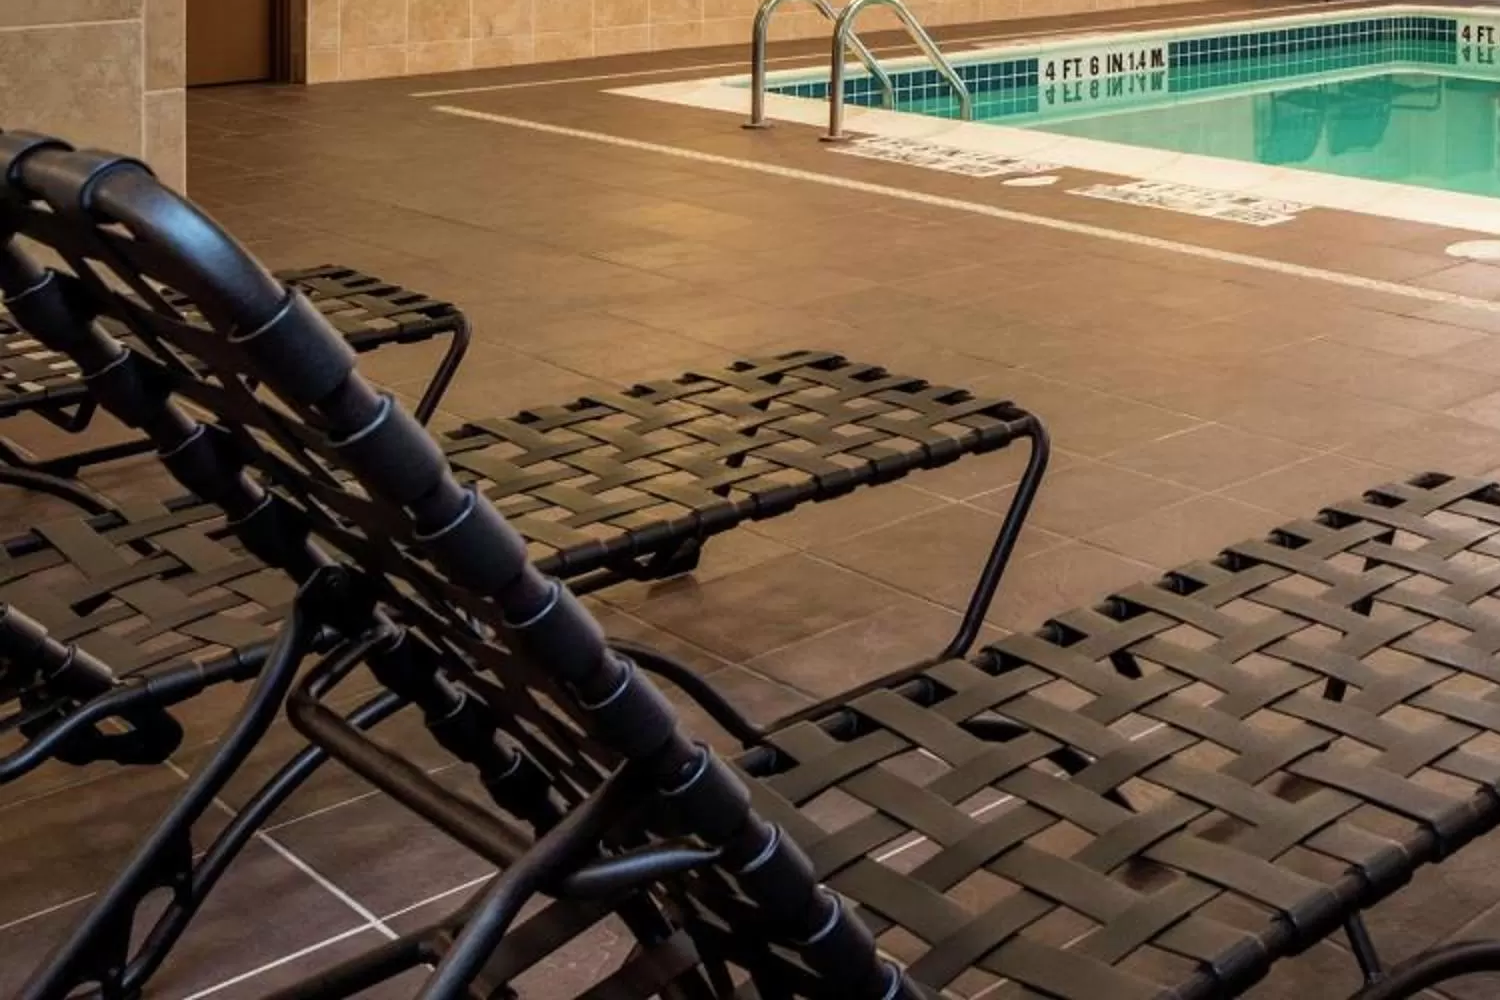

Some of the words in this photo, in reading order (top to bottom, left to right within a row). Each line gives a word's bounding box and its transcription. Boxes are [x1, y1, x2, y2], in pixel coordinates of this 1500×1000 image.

[1461, 25, 1471, 43] 4
[1045, 61, 1056, 81] 4
[1089, 56, 1100, 76] 6
